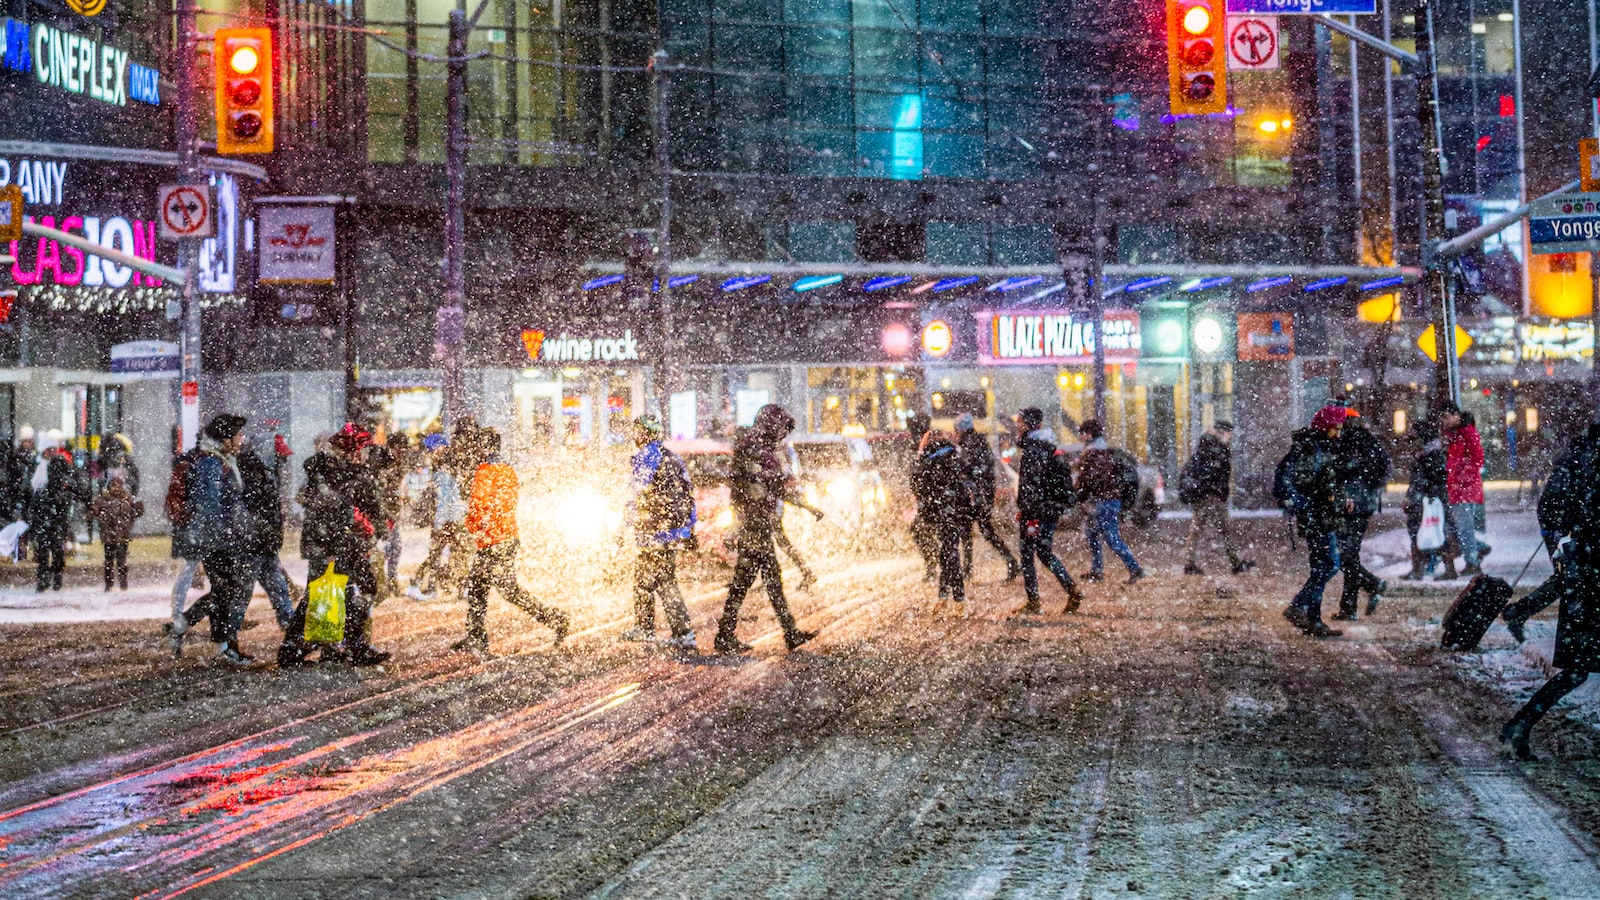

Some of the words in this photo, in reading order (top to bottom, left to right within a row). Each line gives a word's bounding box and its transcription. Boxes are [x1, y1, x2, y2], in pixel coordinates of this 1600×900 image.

[35, 23, 128, 107] CINEPLEX
[130, 63, 160, 105] IMAX
[17, 159, 67, 205] ANY
[1551, 220, 1600, 239] Yonge
[542, 332, 592, 360] wine
[594, 329, 639, 360] rock
[999, 315, 1043, 357] BLAZE
[1044, 314, 1084, 357] PIZZA
